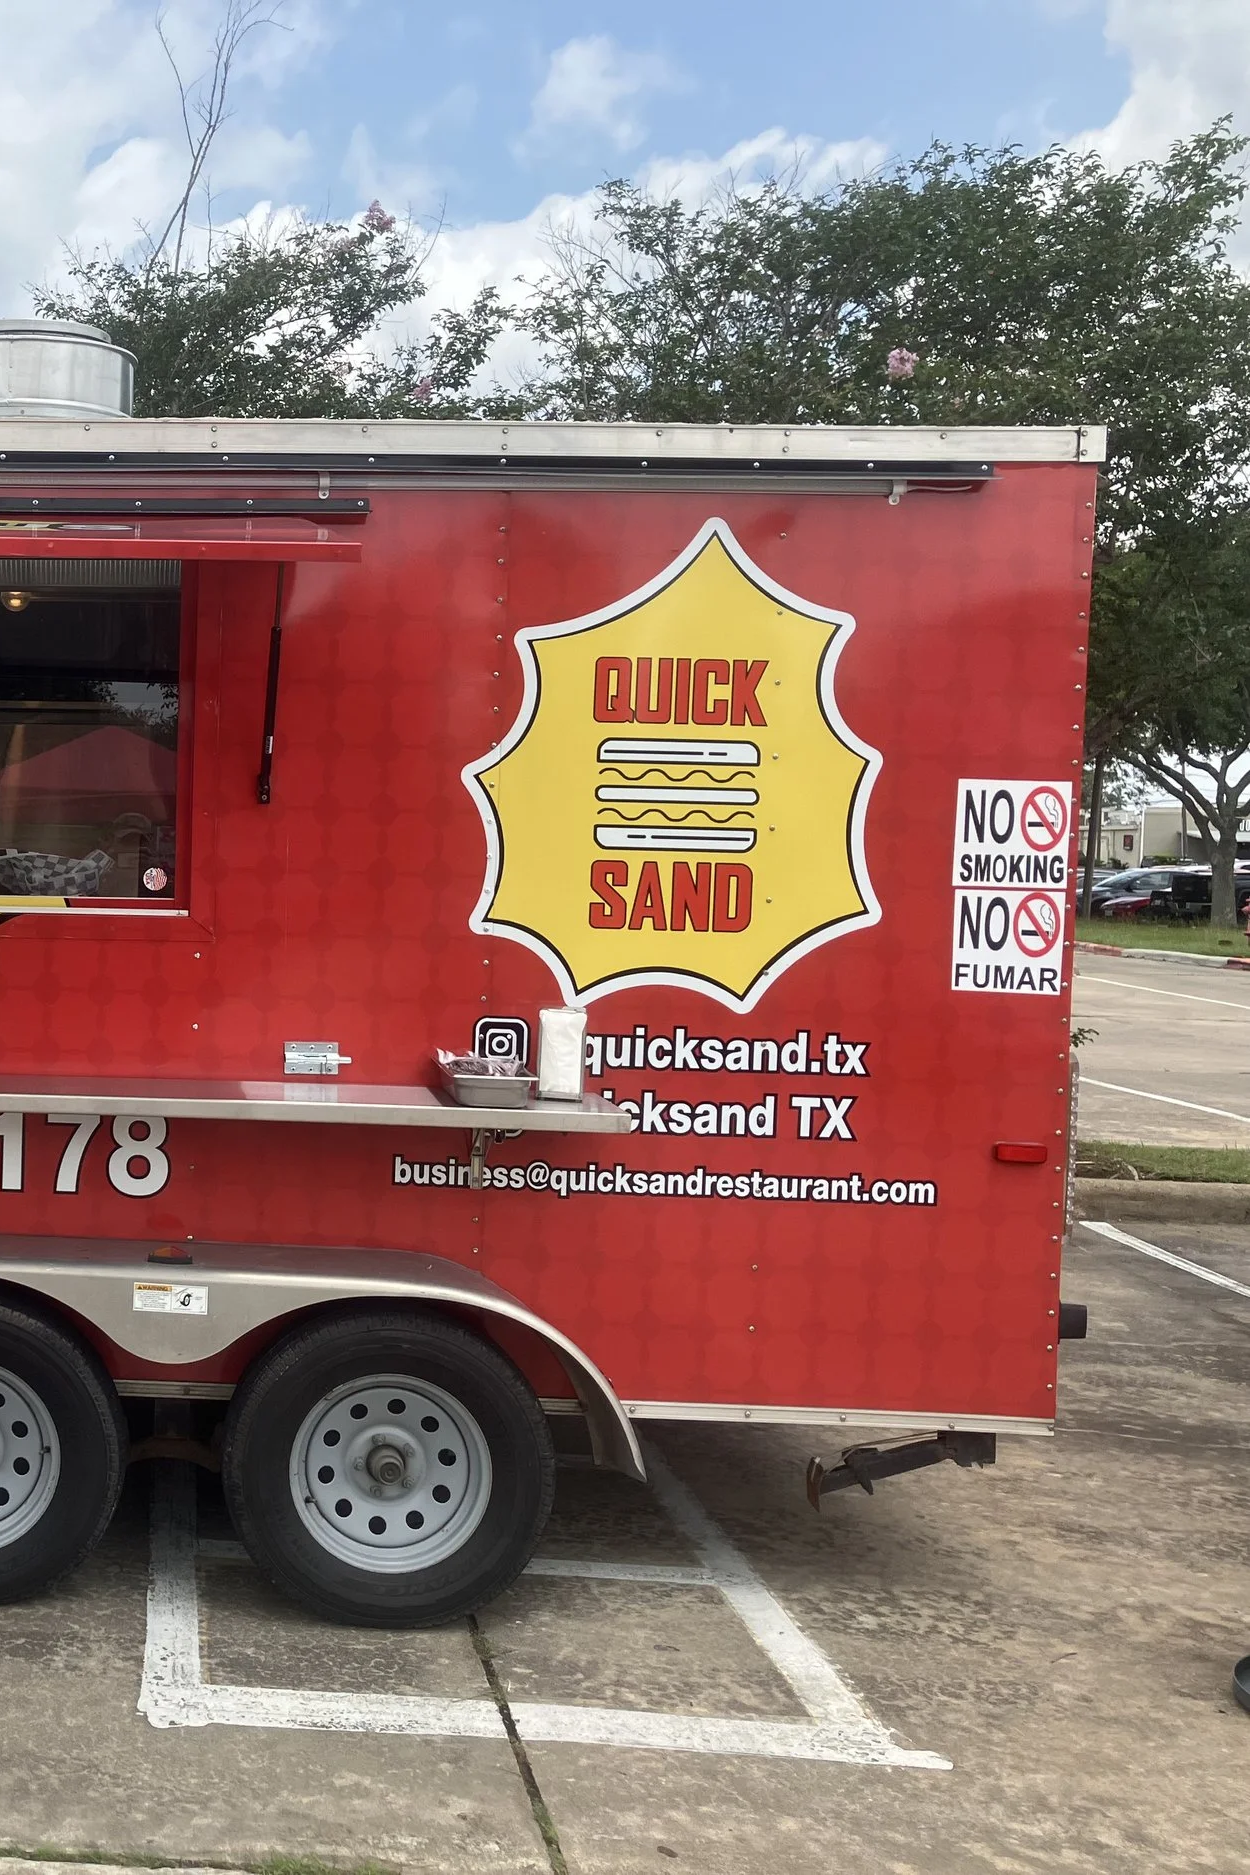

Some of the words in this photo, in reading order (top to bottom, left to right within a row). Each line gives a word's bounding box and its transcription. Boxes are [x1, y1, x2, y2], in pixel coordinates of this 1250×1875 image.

[593, 656, 769, 726] QUICK
[964, 789, 1015, 844] NO
[959, 854, 1064, 883] SMOKING
[589, 860, 753, 933] SAND
[959, 896, 1010, 951] NO
[954, 963, 1058, 991] FUMAR
[585, 1028, 867, 1076] quicksand.tx
[792, 1097, 853, 1139] TX
[393, 1157, 936, 1204] business@quicksandrestaurant.com
